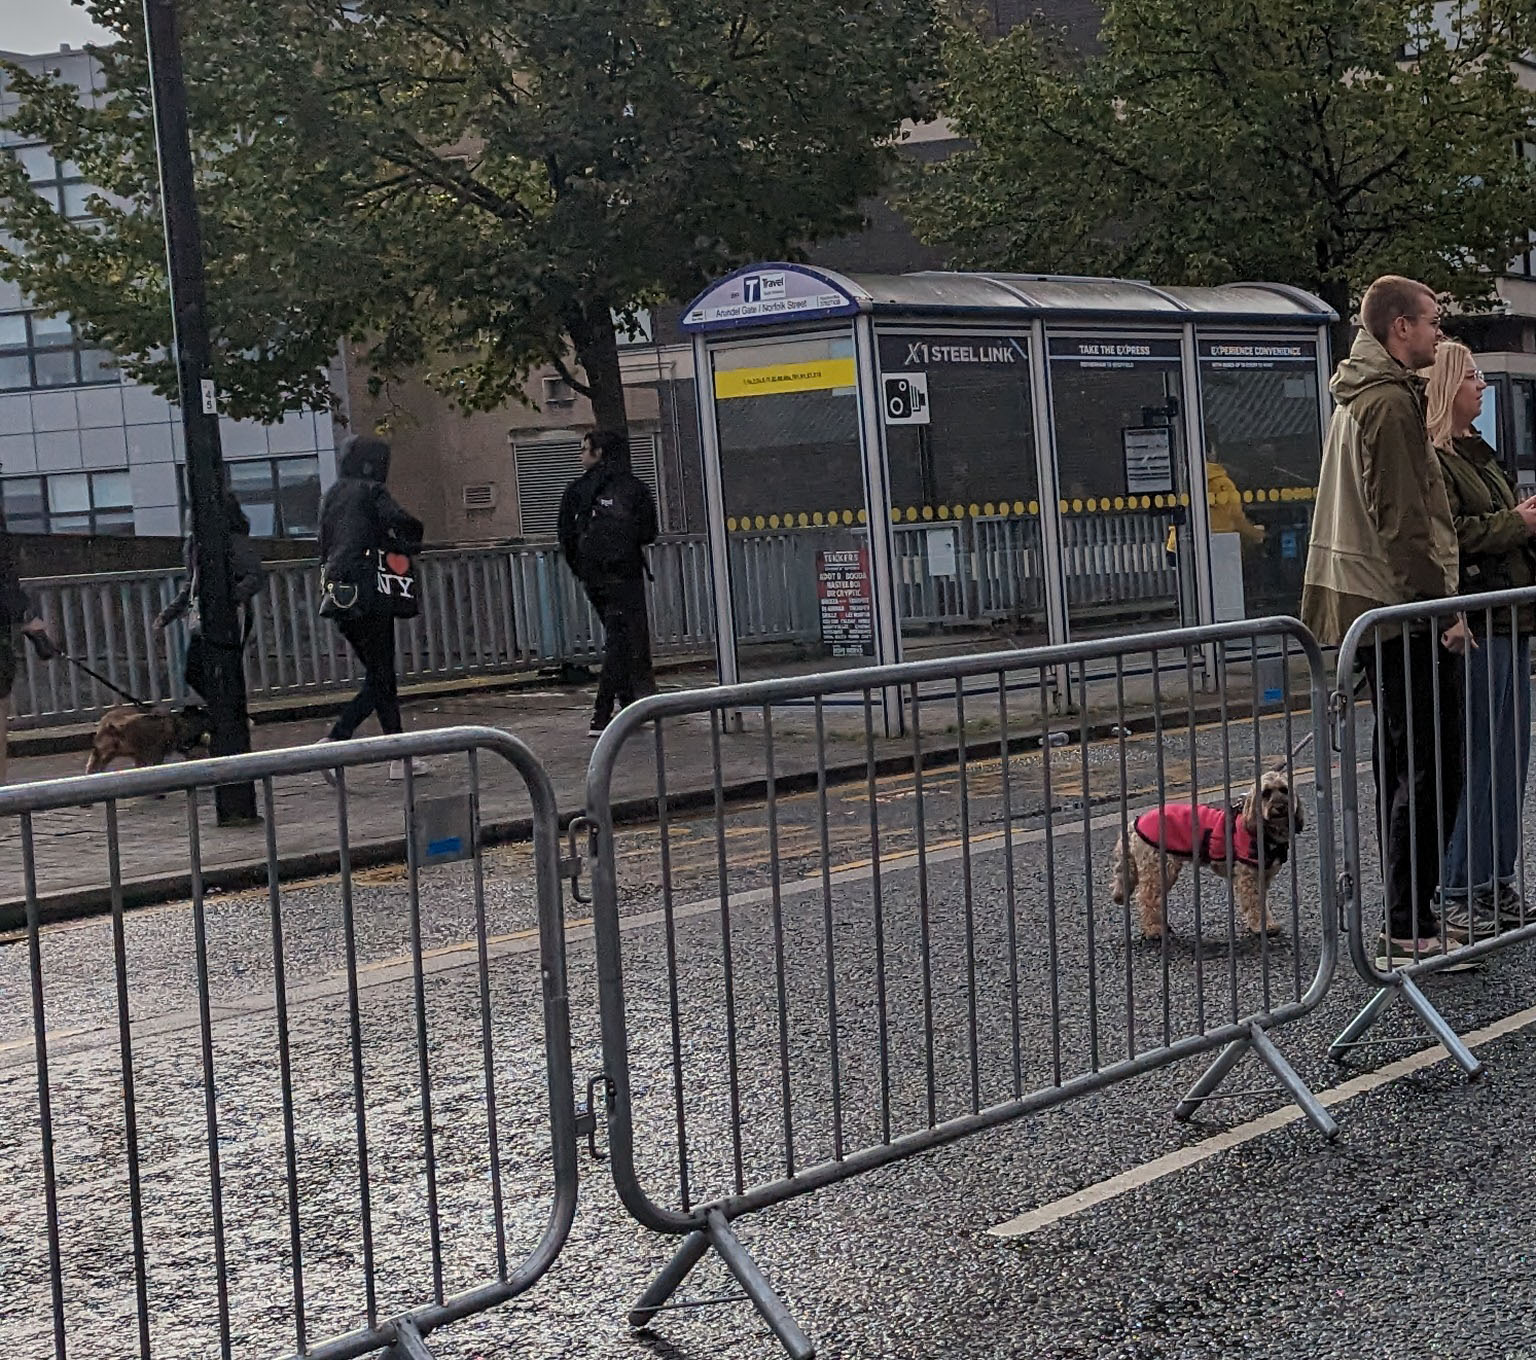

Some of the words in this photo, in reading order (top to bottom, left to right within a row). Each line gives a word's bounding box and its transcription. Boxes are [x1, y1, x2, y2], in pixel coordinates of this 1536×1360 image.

[761, 276, 785, 289] Travel
[715, 307, 741, 318] Arundel
[741, 304, 758, 316] Gate
[762, 301, 786, 314] Norfolk
[787, 298, 808, 311] Street
[1079, 344, 1099, 355] TAKE
[1100, 344, 1116, 355] THE
[1116, 344, 1151, 356] EXPRESS
[1210, 346, 1254, 356] EXPERIENCE
[1254, 346, 1302, 356] CONVENIENCE
[377, 549, 387, 572] I
[376, 571, 415, 599] NY
